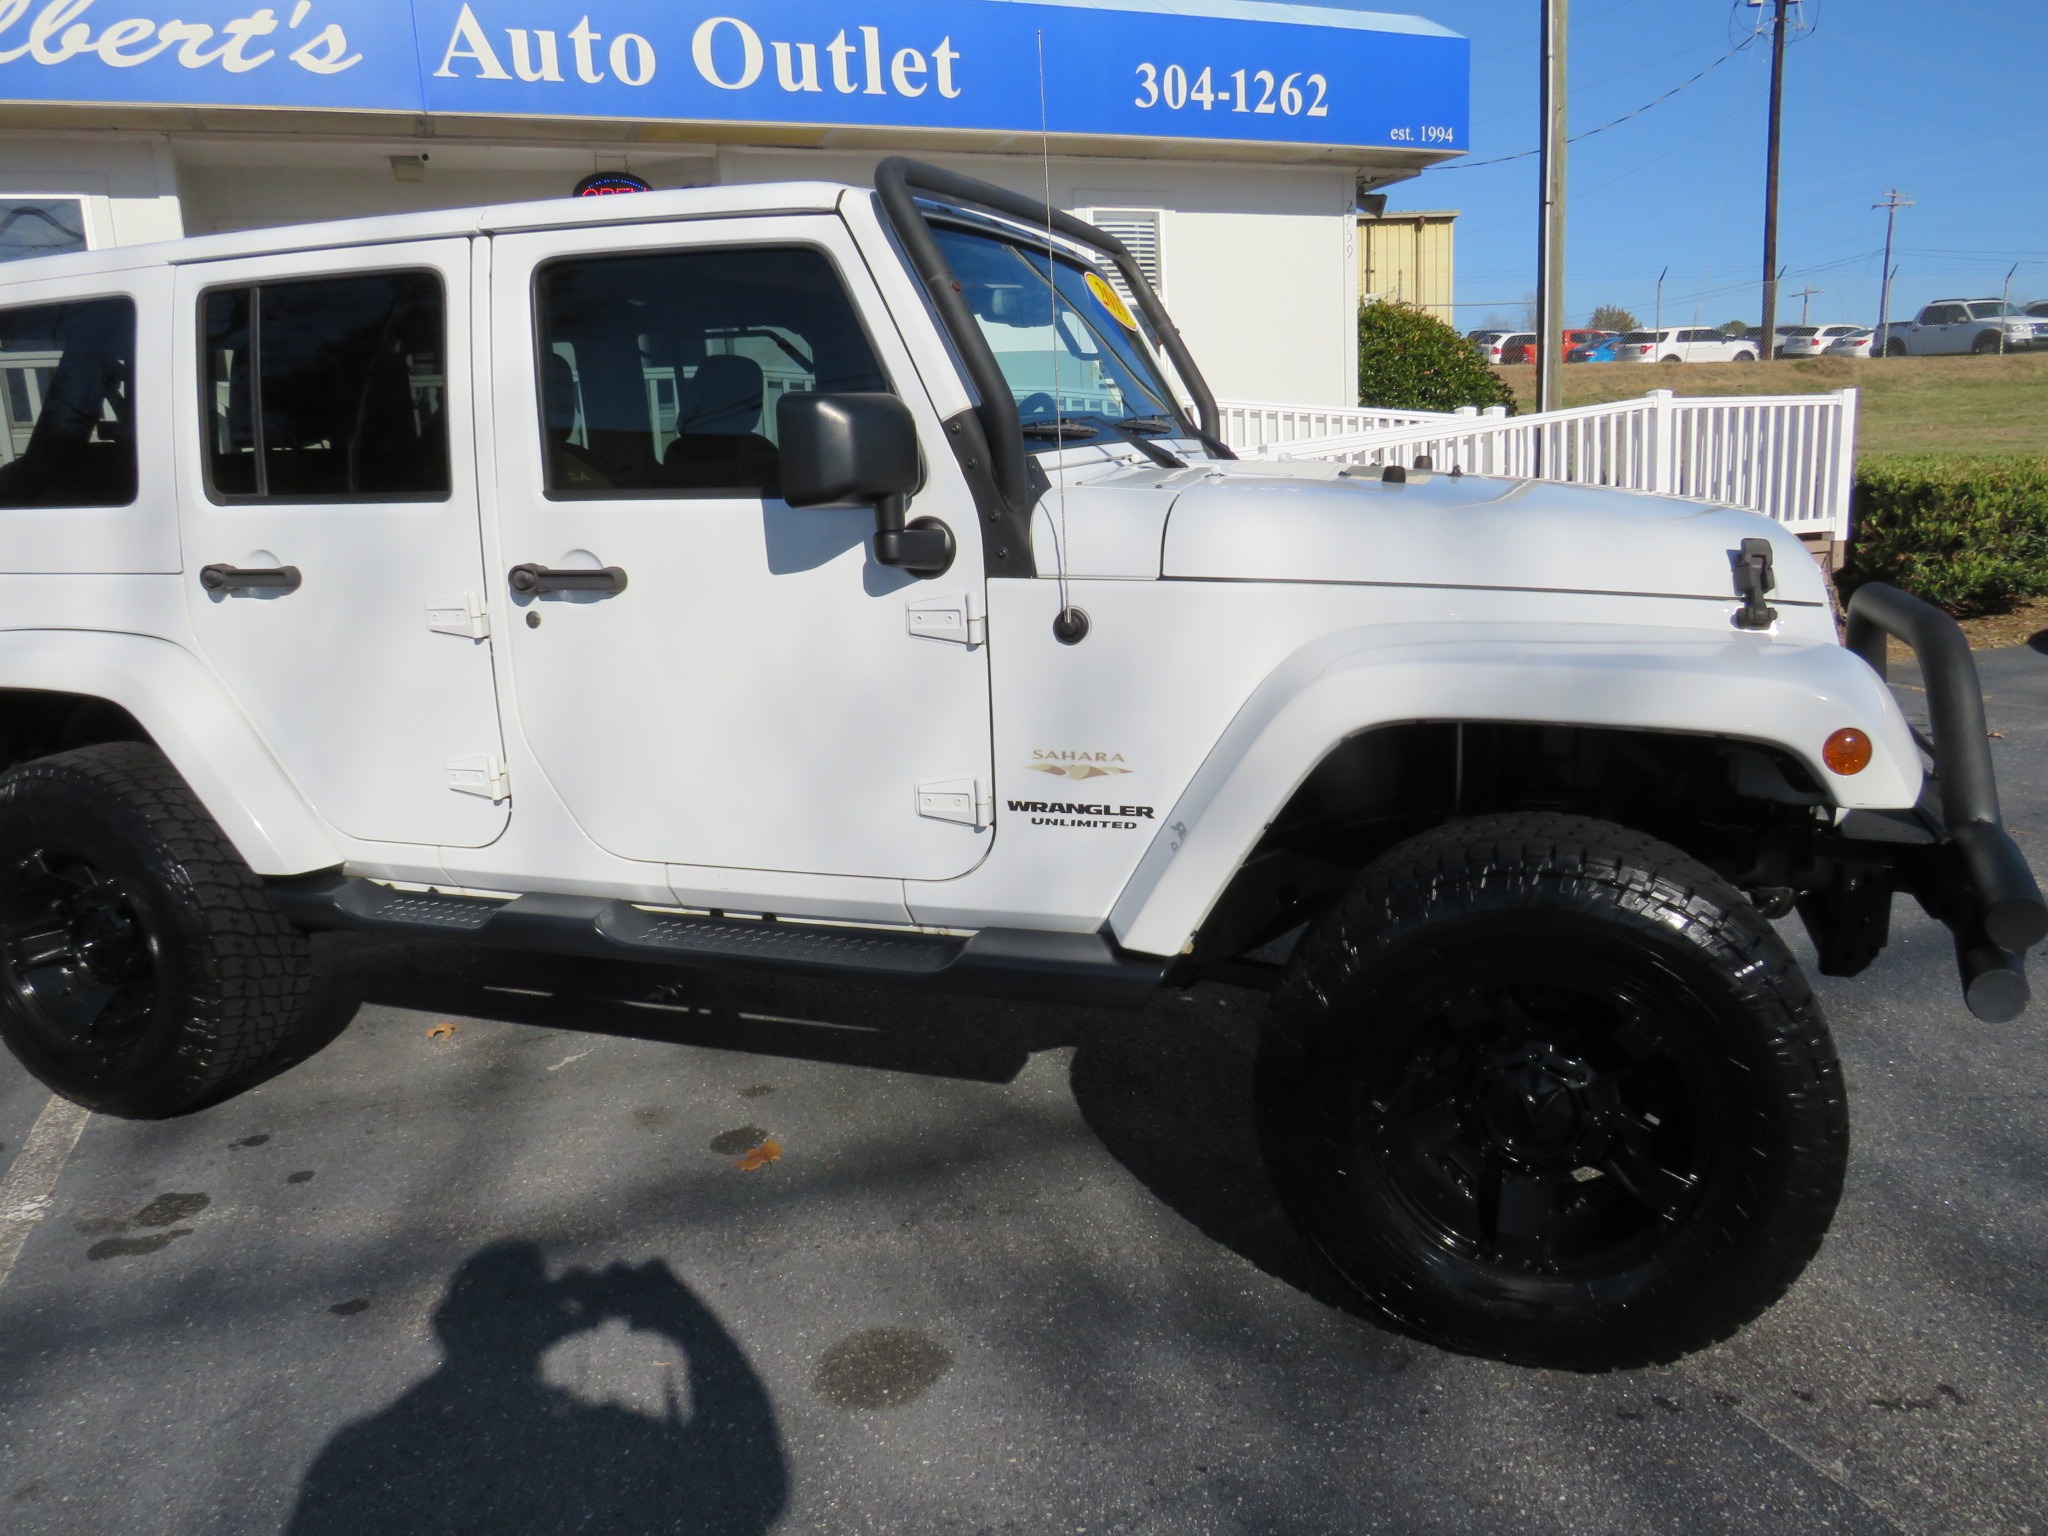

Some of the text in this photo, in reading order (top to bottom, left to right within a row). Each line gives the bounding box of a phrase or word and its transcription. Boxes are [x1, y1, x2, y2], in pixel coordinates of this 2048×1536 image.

[433, 2, 656, 87] Auto
[692, 16, 961, 98] Outlet
[1135, 63, 1328, 117] 304-1262
[1390, 125, 1453, 143] est. 1994
[1032, 750, 1126, 763] SAHARA
[1007, 800, 1156, 819] WRANGLER
[1031, 817, 1138, 830] UNLIMITED
